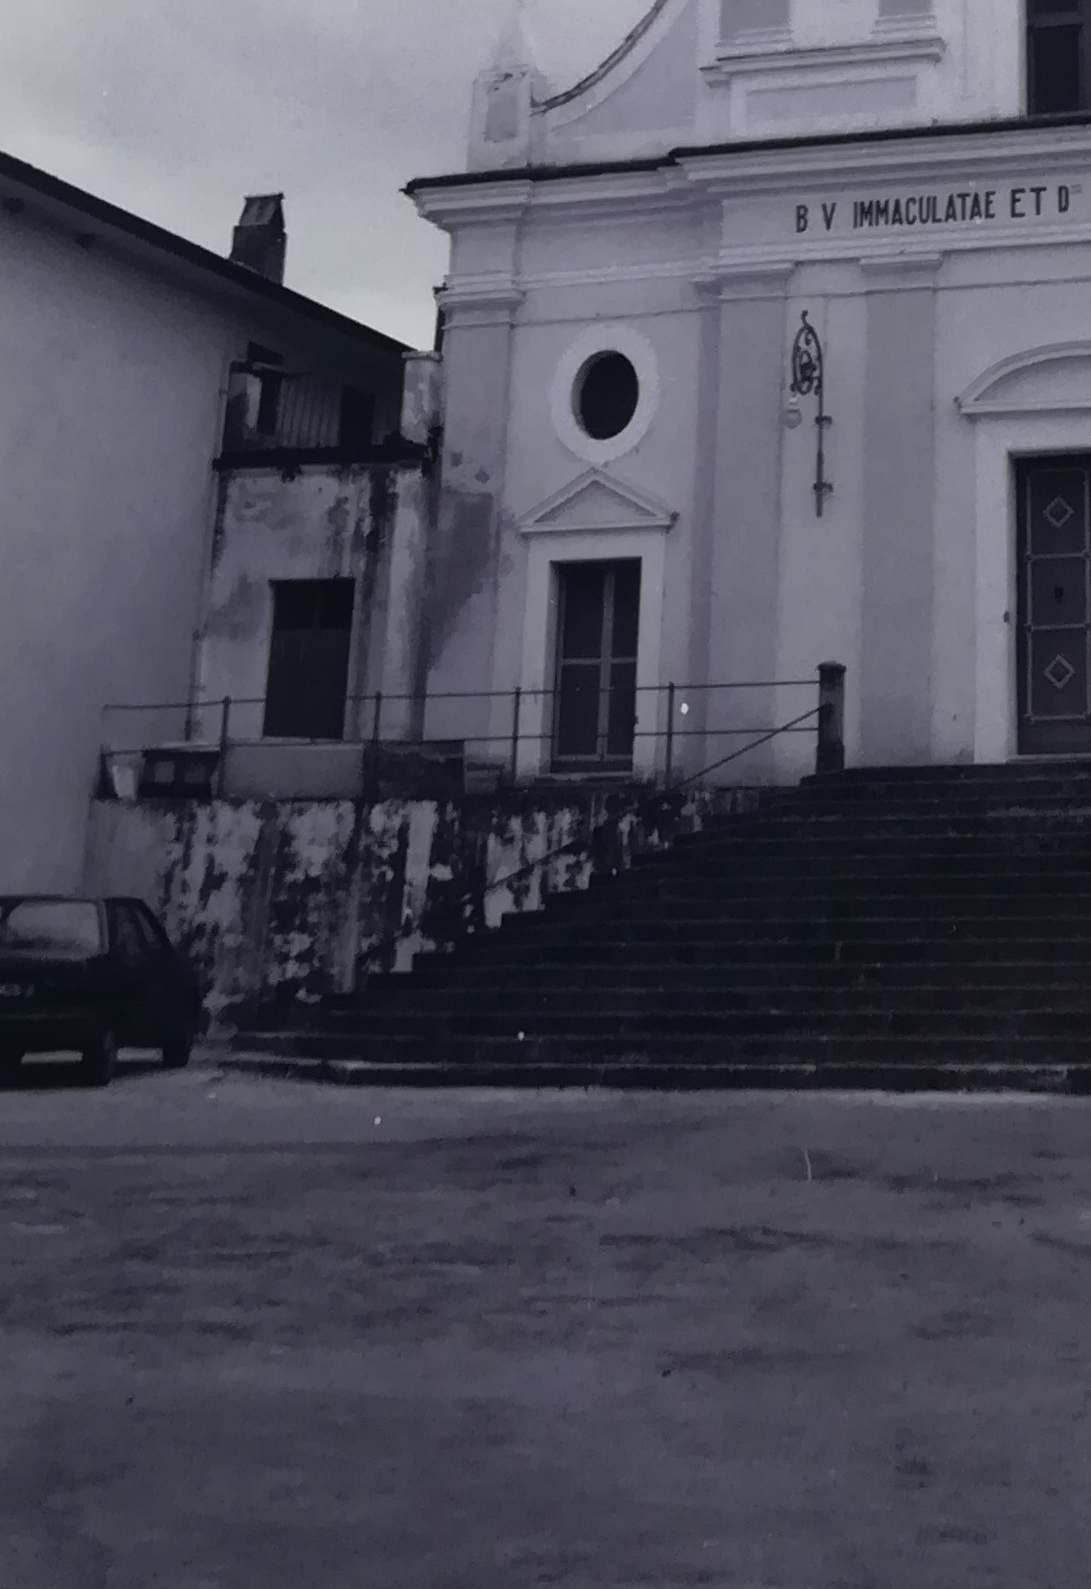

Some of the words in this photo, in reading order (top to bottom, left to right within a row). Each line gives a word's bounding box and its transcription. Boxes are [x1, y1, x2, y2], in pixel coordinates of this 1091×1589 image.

[796, 205, 809, 234] B
[821, 203, 837, 232] V
[853, 193, 996, 230] IMMACULATAE
[1010, 187, 1047, 219] ET
